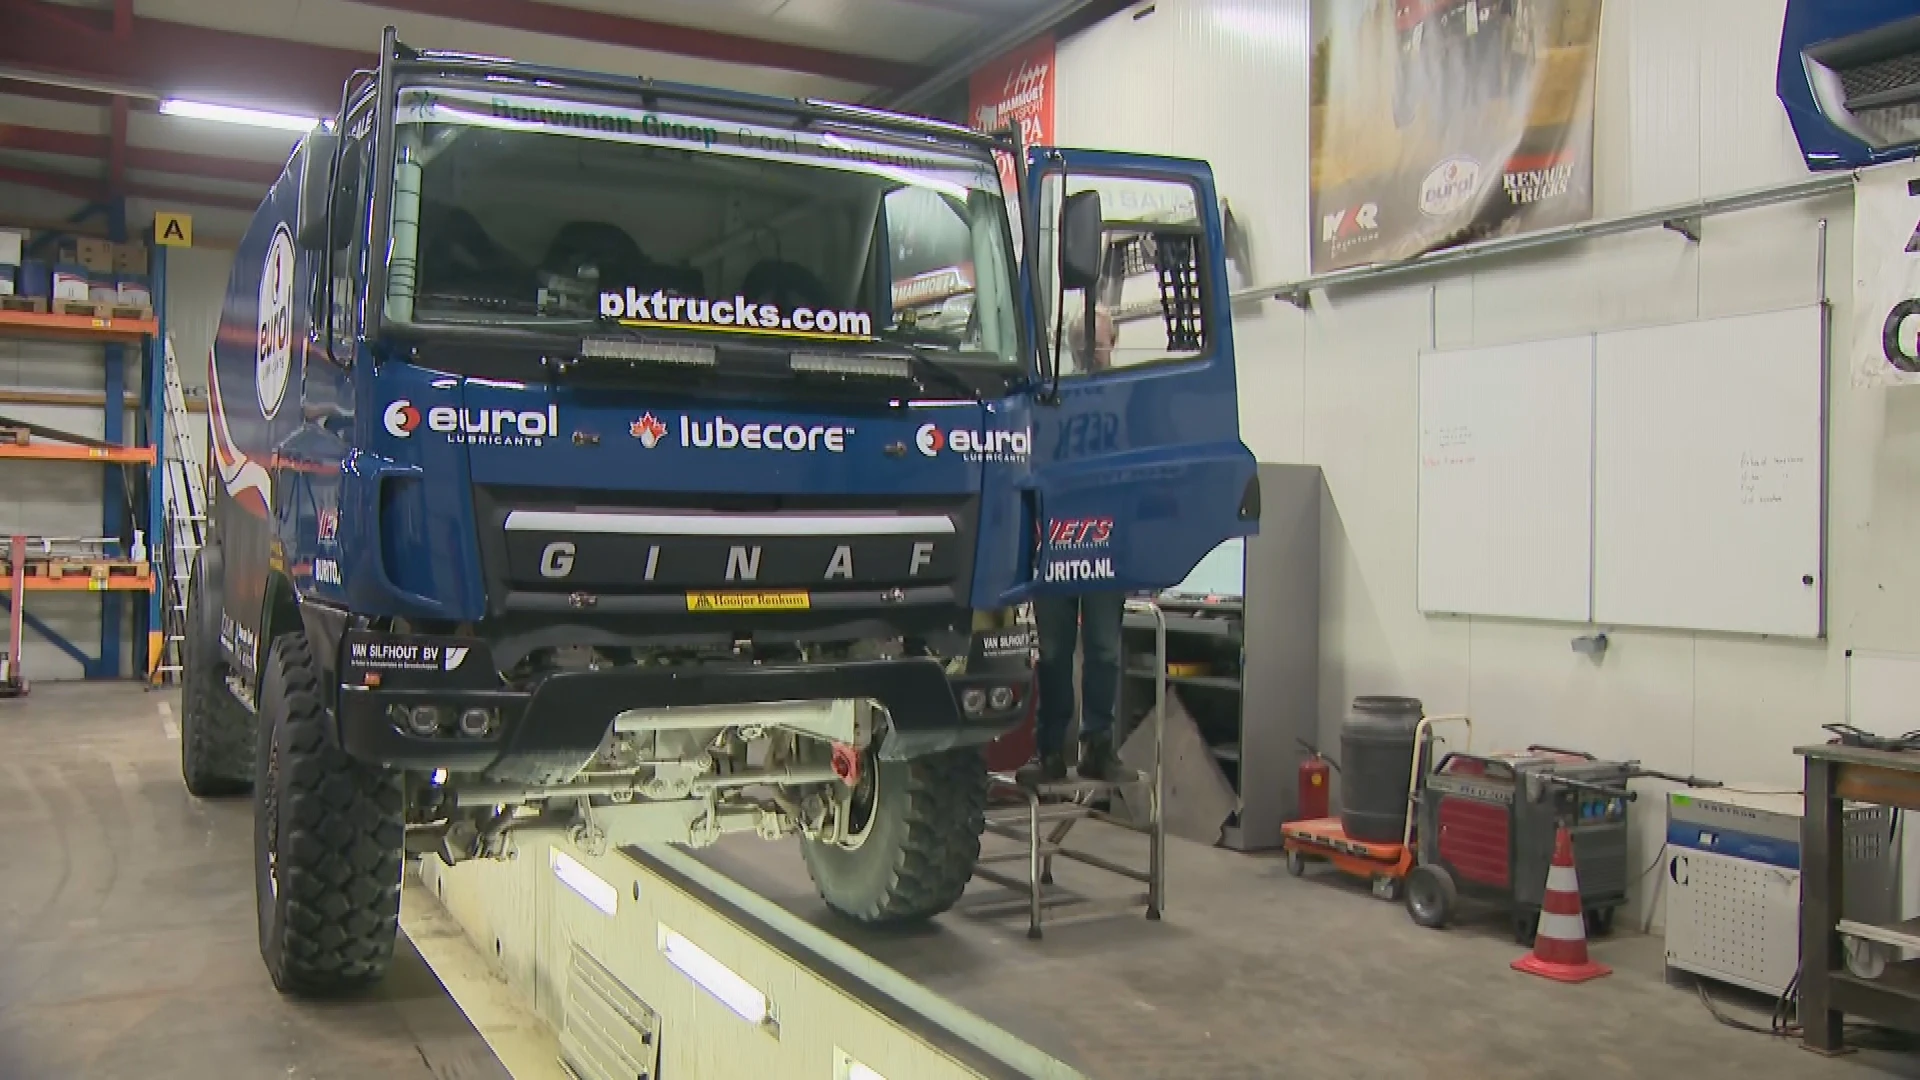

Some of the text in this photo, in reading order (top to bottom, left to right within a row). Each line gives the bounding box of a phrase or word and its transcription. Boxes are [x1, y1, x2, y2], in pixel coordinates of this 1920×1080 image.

[738, 126, 797, 154] Cool
[1504, 162, 1574, 190] RENAULT
[1508, 182, 1569, 204] TRUCKS
[163, 219, 184, 241] A
[260, 283, 292, 363] eurol
[600, 286, 871, 335] pktrucks.com
[428, 403, 558, 437] eurol
[447, 433, 543, 447] LUBRICANTS
[948, 425, 1032, 455] eurol
[962, 453, 1026, 463] LUBRICANTS
[351, 643, 438, 659] VAN SILFHOUT BV
[983, 637, 998, 649] VAN
